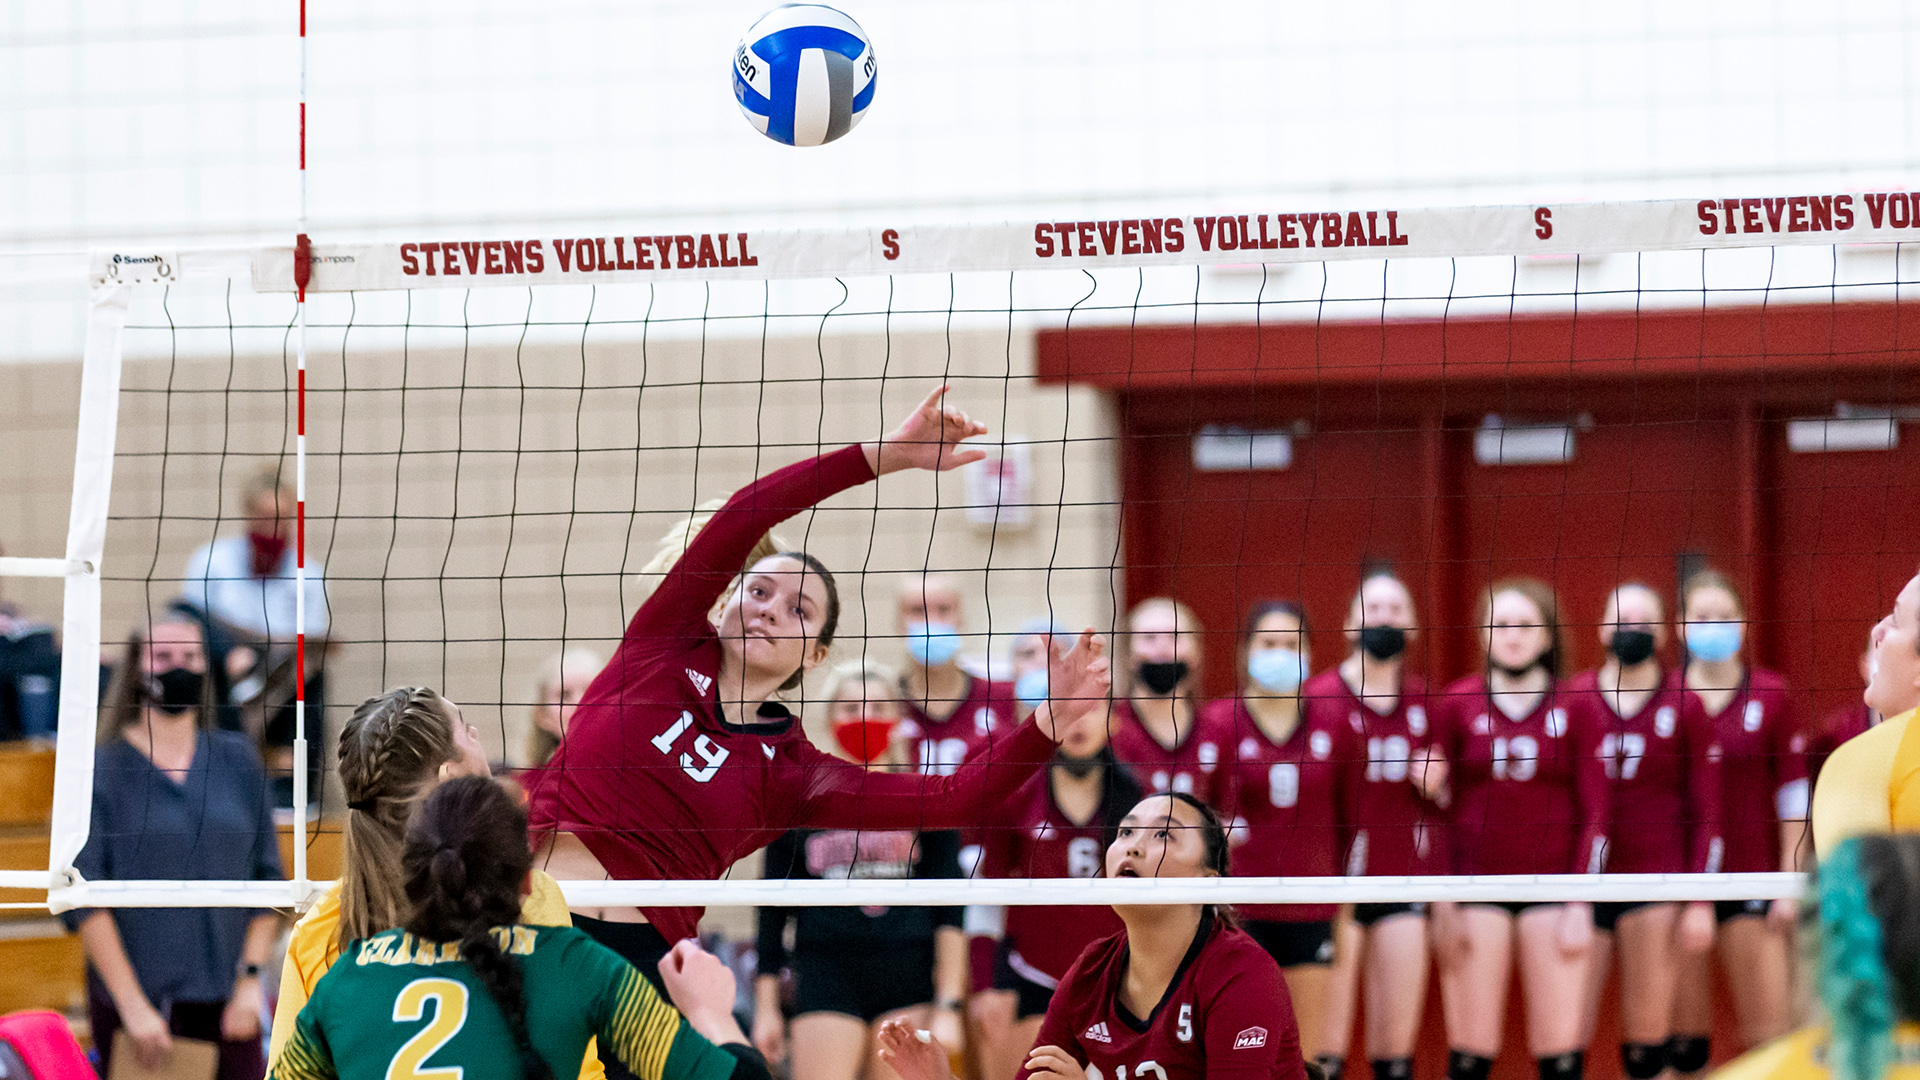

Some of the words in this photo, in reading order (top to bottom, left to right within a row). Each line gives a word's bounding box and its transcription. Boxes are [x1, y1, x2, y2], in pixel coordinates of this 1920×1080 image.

[735, 43, 757, 82] lten
[1036, 219, 1184, 256] STEVENS
[1194, 212, 1407, 251] VOLLEYBALL
[1536, 208, 1552, 239] S
[1698, 196, 1853, 234] STEVENS
[1864, 193, 1920, 228] VOL
[123, 254, 163, 264] Senoh
[401, 240, 543, 275] STEVENS
[553, 234, 757, 271] VOLLEYBALL
[882, 230, 899, 260] S
[650, 709, 730, 783] 19
[355, 925, 539, 967] CLARKON
[385, 978, 469, 1080] 2
[1237, 1036, 1264, 1047] MAC
